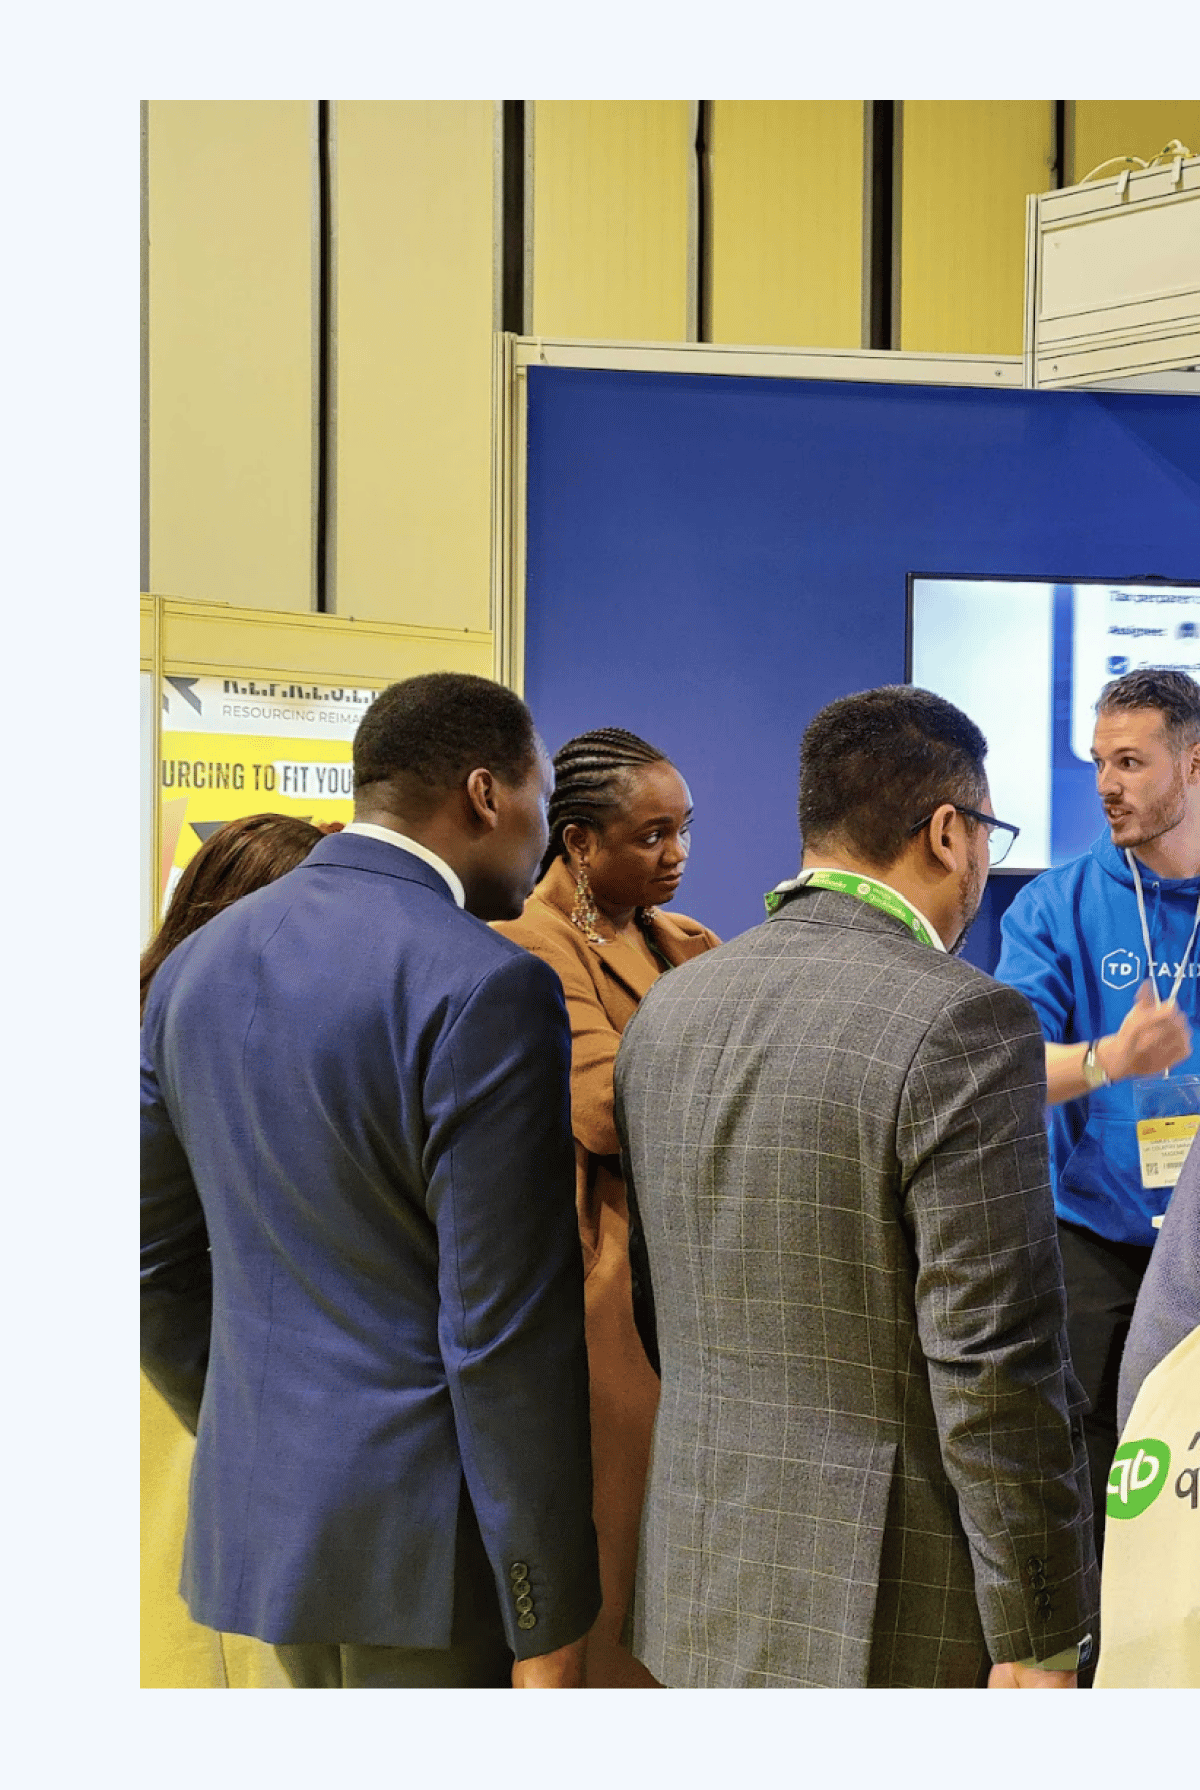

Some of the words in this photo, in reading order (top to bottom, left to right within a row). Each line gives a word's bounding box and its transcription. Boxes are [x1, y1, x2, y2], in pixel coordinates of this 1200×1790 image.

[222, 705, 315, 722] RESOURCING
[252, 763, 275, 792] TO
[283, 765, 309, 793] FIT
[1108, 962, 1132, 976] TD
